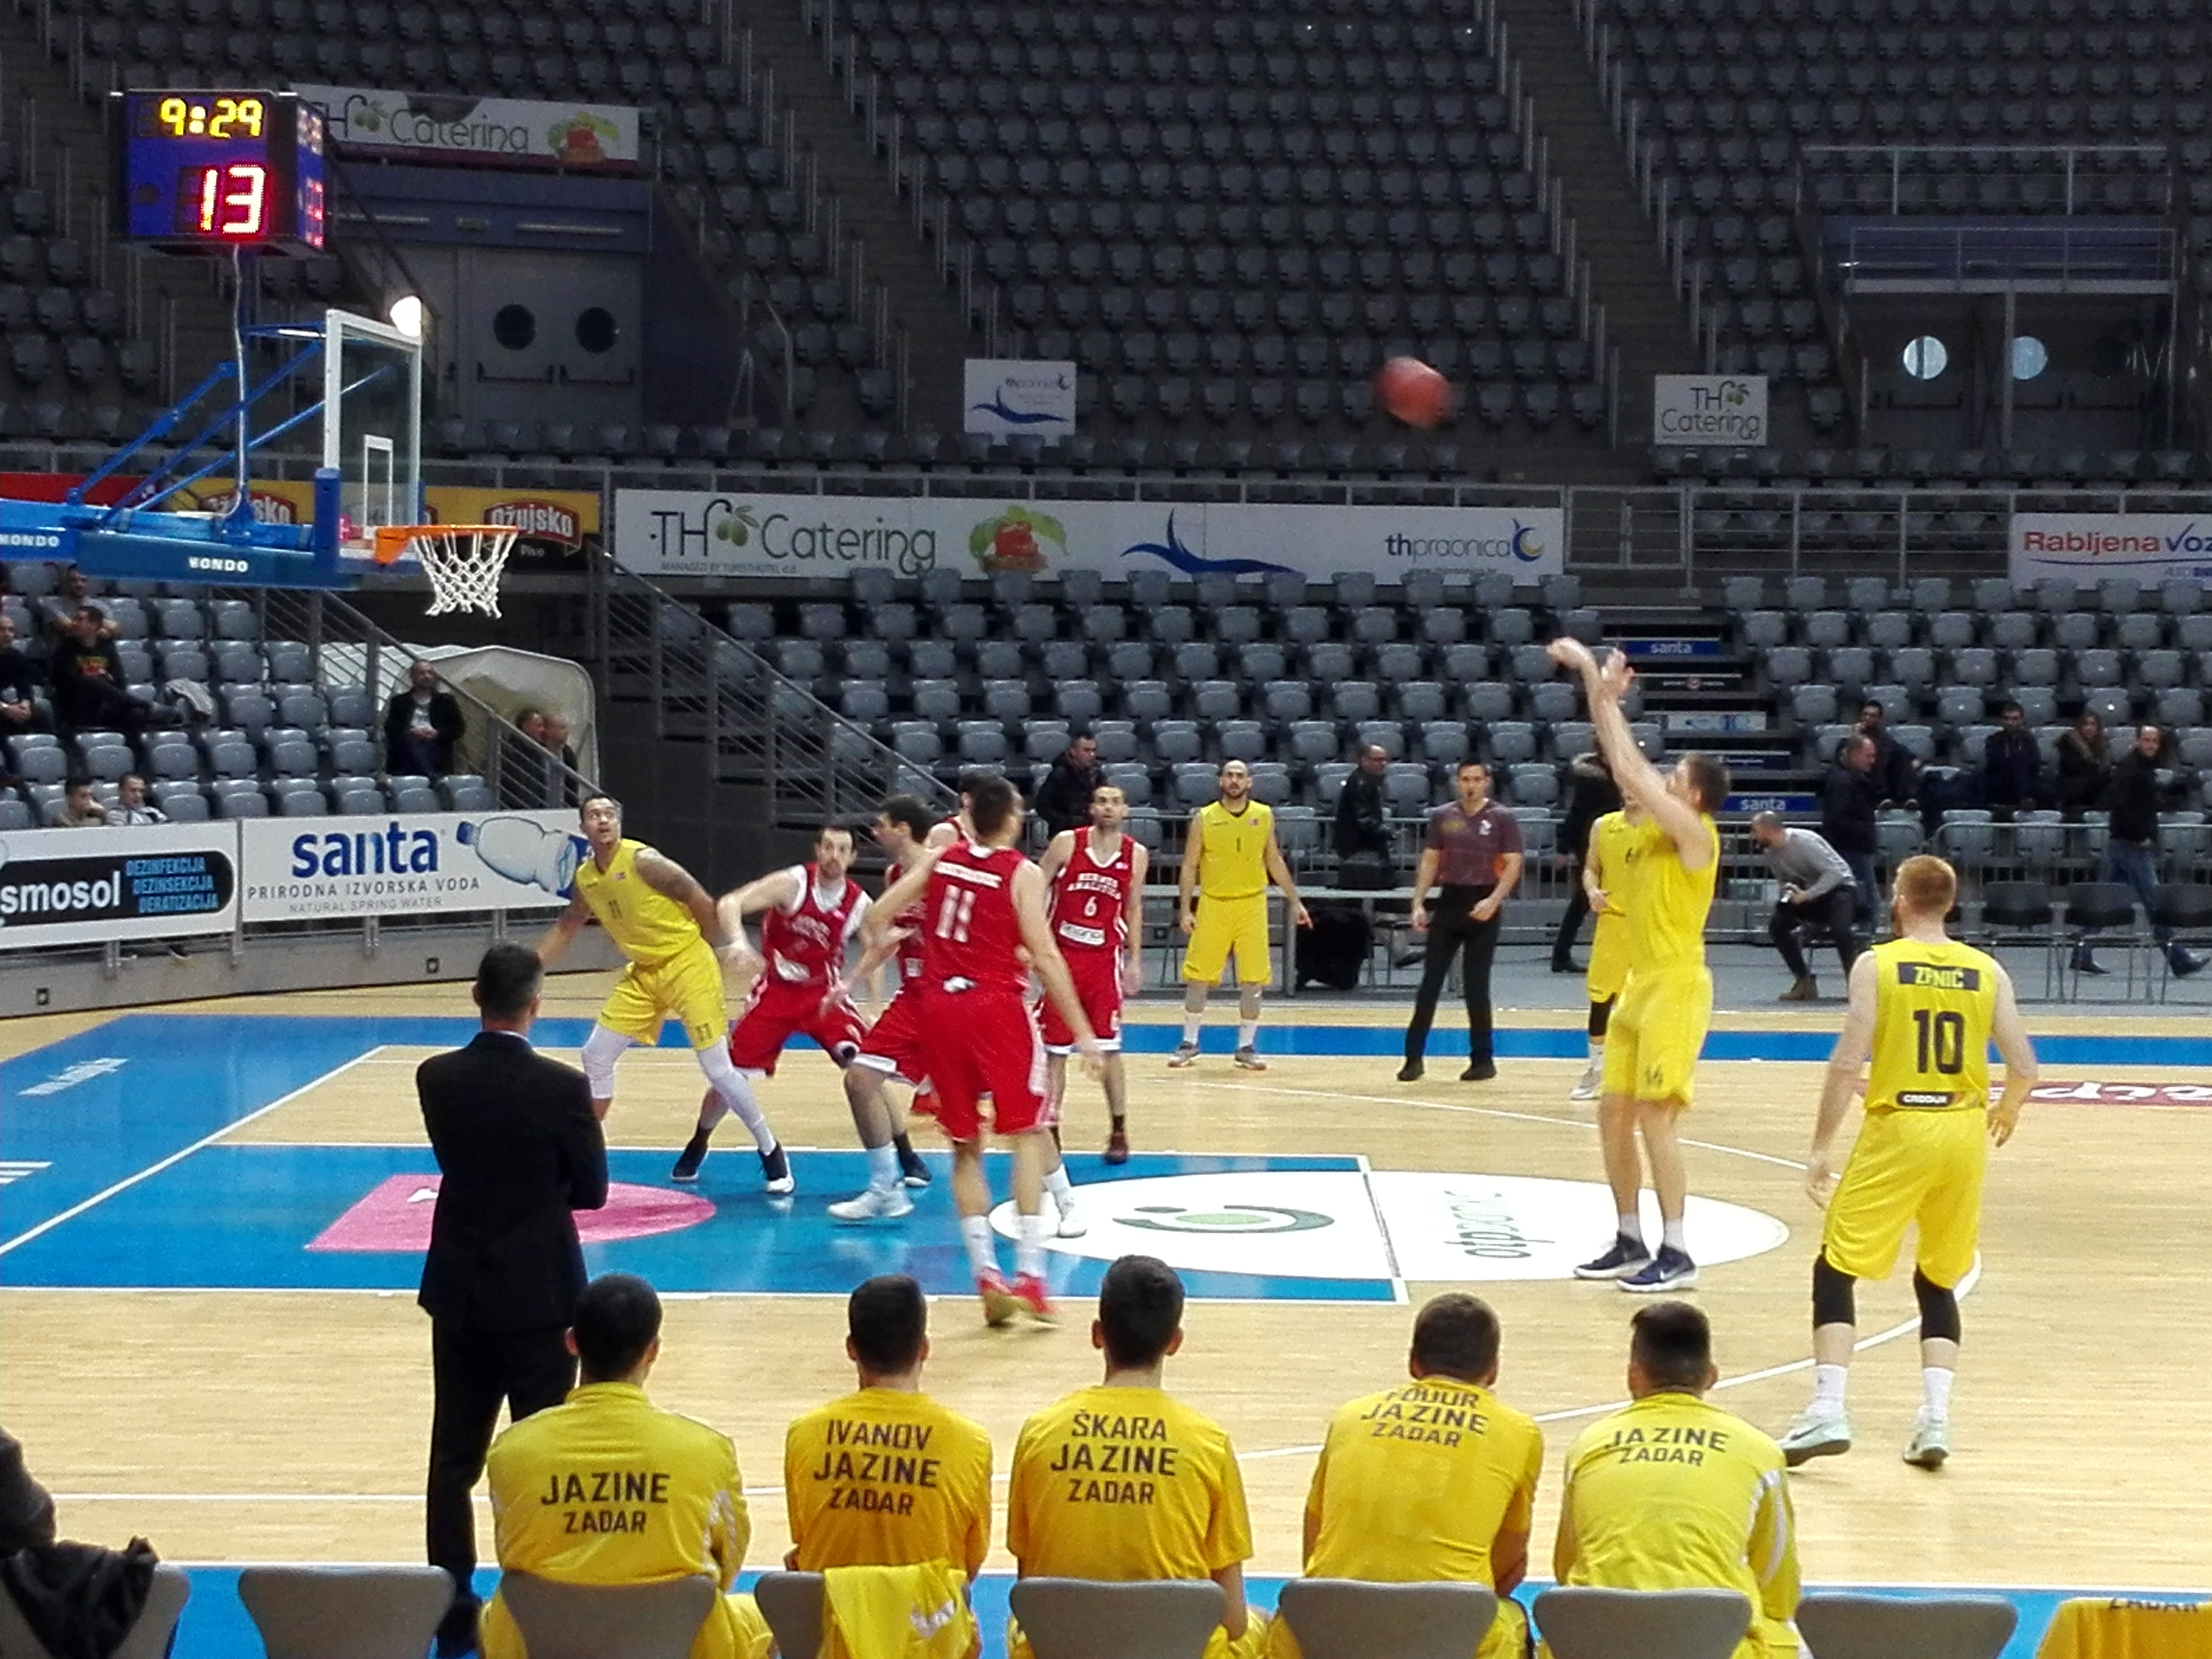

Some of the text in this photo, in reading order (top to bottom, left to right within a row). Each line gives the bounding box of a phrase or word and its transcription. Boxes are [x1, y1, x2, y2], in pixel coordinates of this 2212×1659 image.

[161, 98, 264, 138] 9:29
[200, 166, 267, 234] 13
[1661, 408, 1761, 440] Catering
[761, 514, 936, 575] Catering
[2024, 532, 2160, 555] Rabljena
[1650, 641, 1692, 653] santa
[1740, 798, 1787, 811] santa
[292, 821, 439, 878] santa
[1, 870, 121, 914] smosol
[247, 877, 480, 900] PRIRODNA IZVORSKA VODA
[289, 896, 443, 914] NATURAL SPRING WATER
[935, 884, 977, 943] 11
[1084, 896, 1098, 922] 6
[1913, 1009, 1964, 1074] 10
[826, 1419, 933, 1451] IVANOV
[1071, 1409, 1167, 1441] ŠKARA
[1361, 1403, 1488, 1435] JAZINE
[1372, 1421, 1462, 1447] ZADAR
[1604, 1428, 1729, 1453] JAZINE
[813, 1452, 941, 1488] JAZINE
[1050, 1443, 1178, 1476] JAZINE
[1619, 1447, 1704, 1467] ZADAR
[541, 1472, 671, 1505] JAZINE
[828, 1487, 914, 1515] ZADAR
[1068, 1479, 1154, 1504] ZADAR
[564, 1510, 647, 1534] ZADAR
